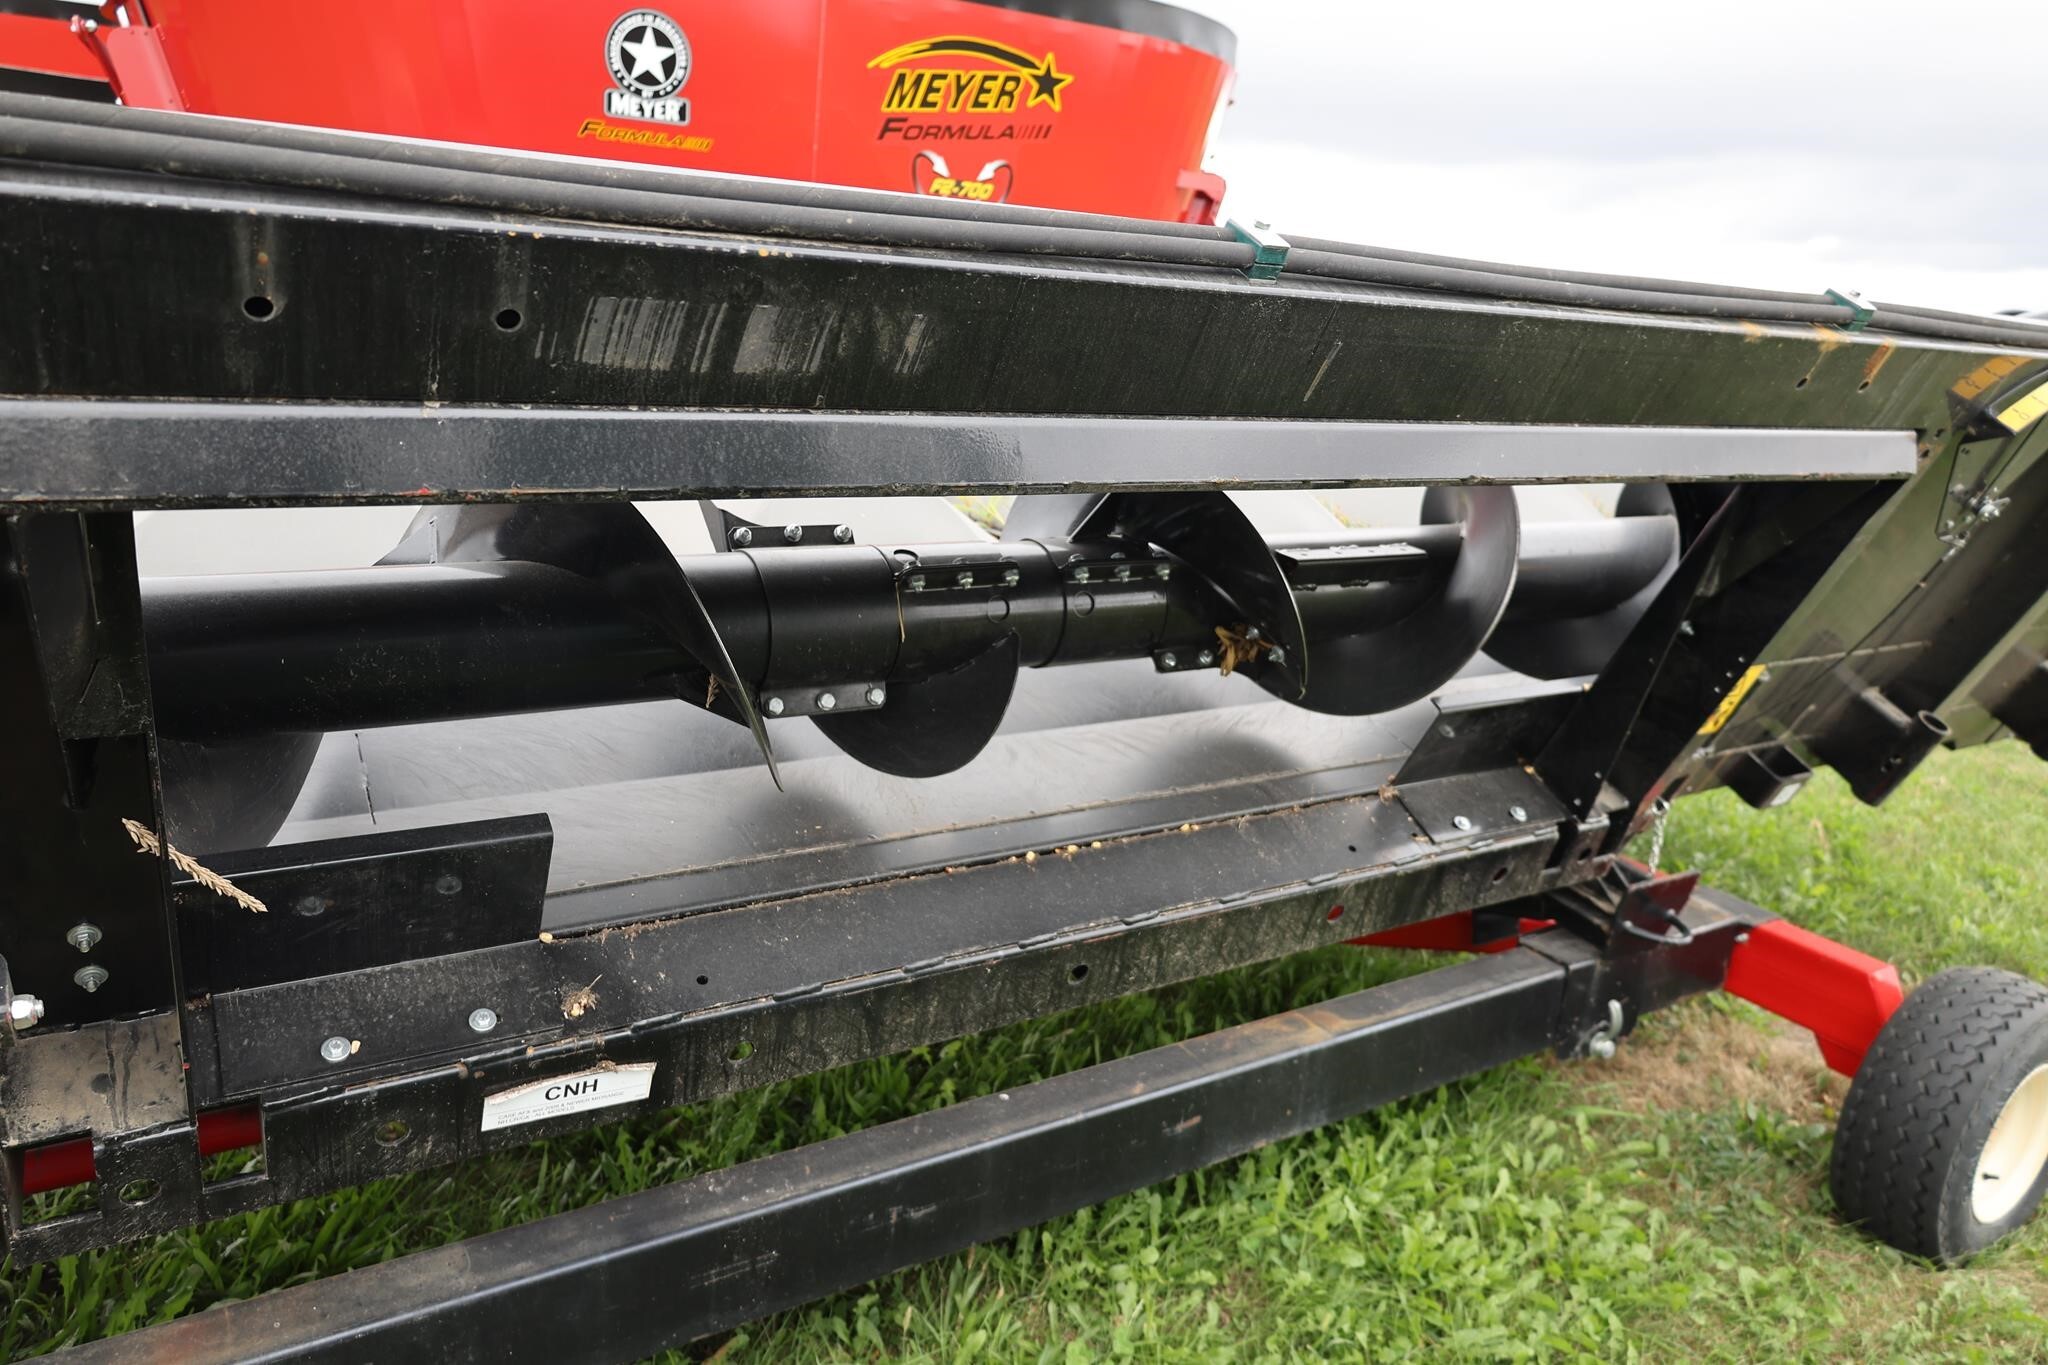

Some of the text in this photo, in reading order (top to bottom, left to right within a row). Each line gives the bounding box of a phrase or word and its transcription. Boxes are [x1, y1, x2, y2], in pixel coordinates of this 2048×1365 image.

[882, 70, 1023, 112] MEYER
[610, 91, 682, 122] MEYER
[878, 117, 1014, 140] FORMULA
[545, 1078, 599, 1101] CNH
